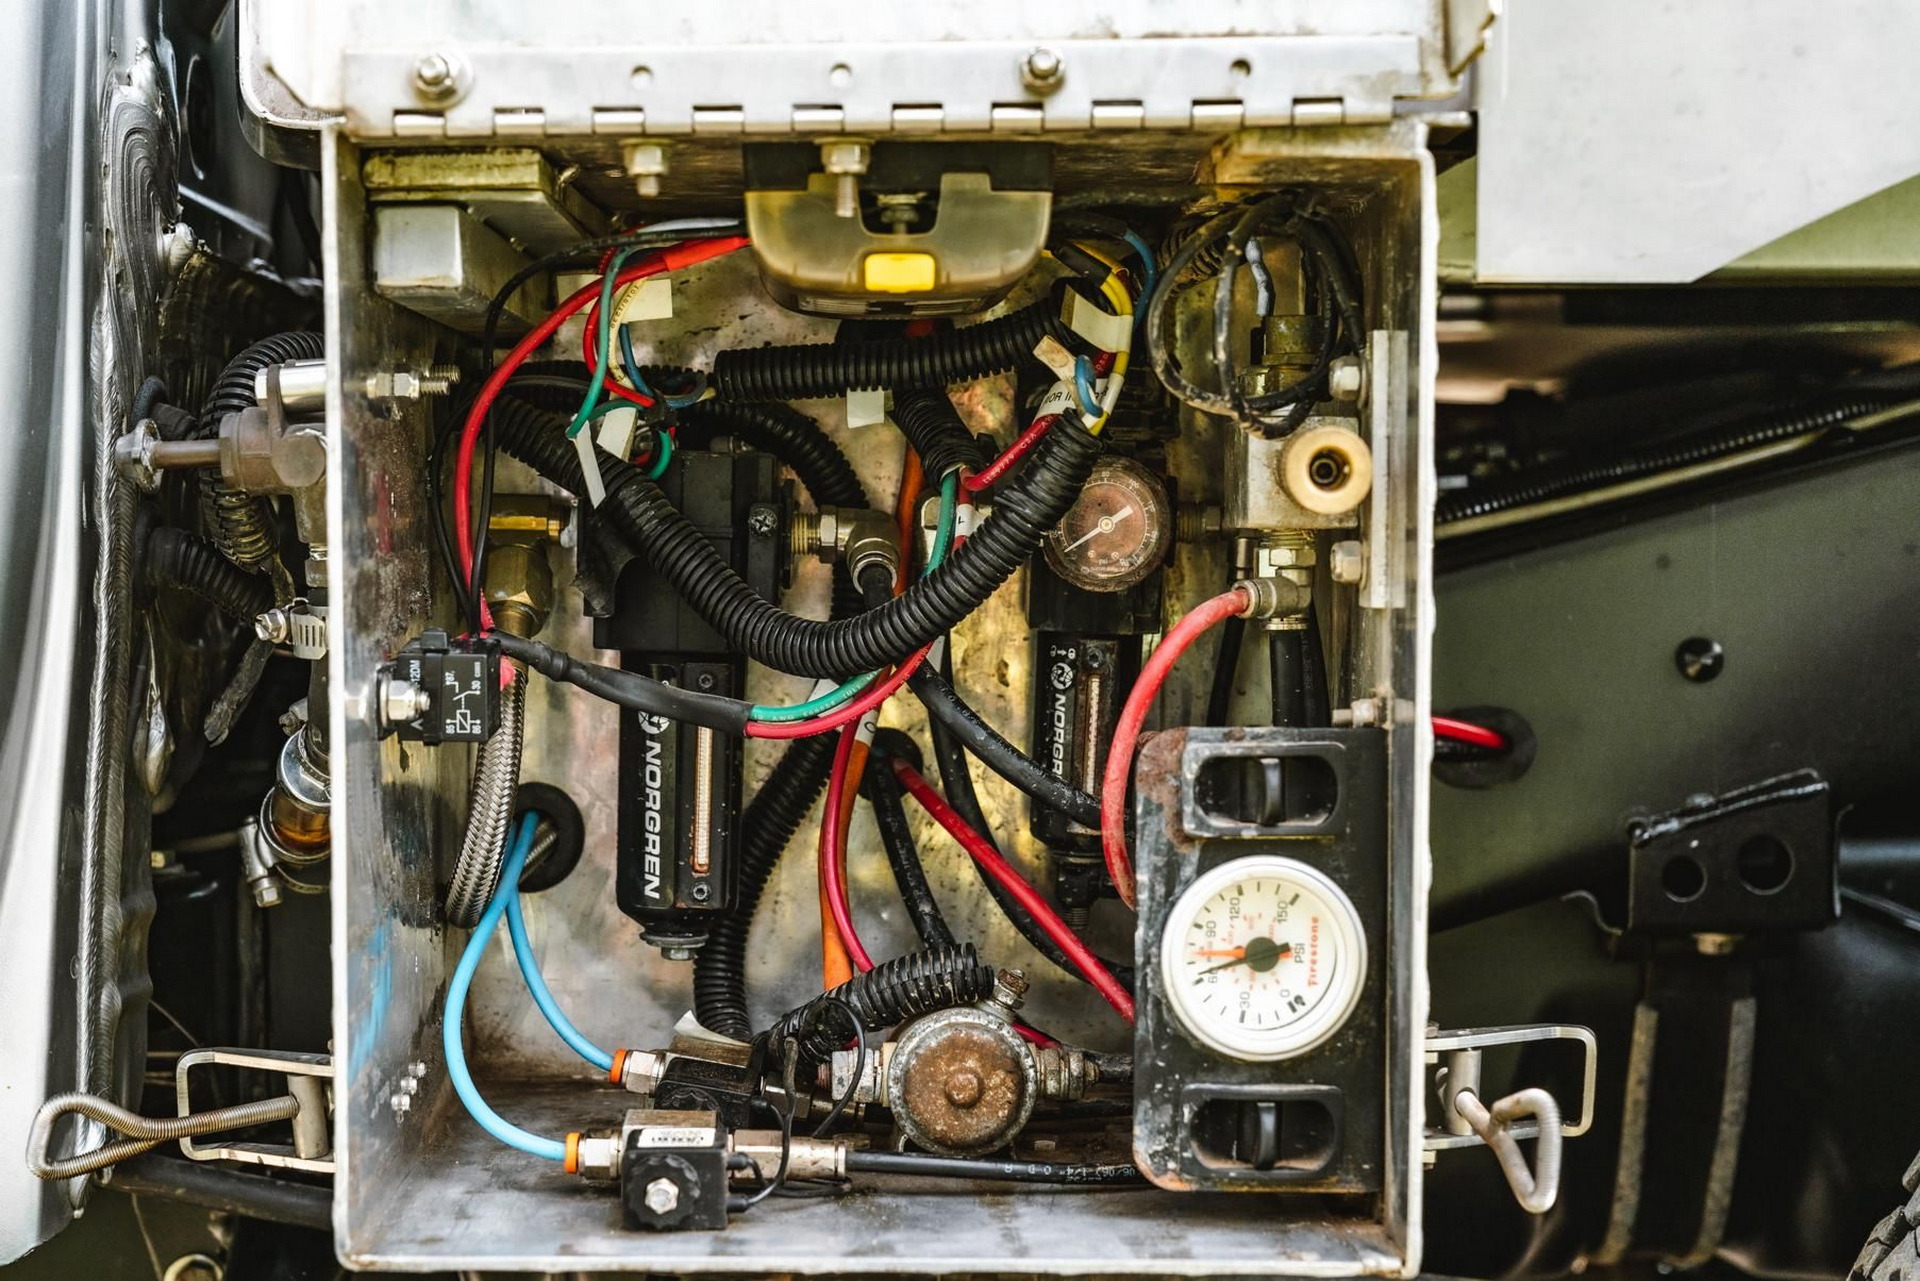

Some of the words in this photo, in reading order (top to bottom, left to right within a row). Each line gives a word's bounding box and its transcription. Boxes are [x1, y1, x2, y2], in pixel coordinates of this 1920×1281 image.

[1052, 693, 1066, 777] NORGR
[643, 740, 661, 899] NORGREN
[1229, 897, 1240, 921] 120
[1277, 900, 1288, 924] 150
[1206, 920, 1217, 938] 90
[1294, 942, 1305, 963] PSI
[1307, 916, 1319, 988] Firestone
[1239, 991, 1250, 1009] 30
[1279, 989, 1291, 998] 0
